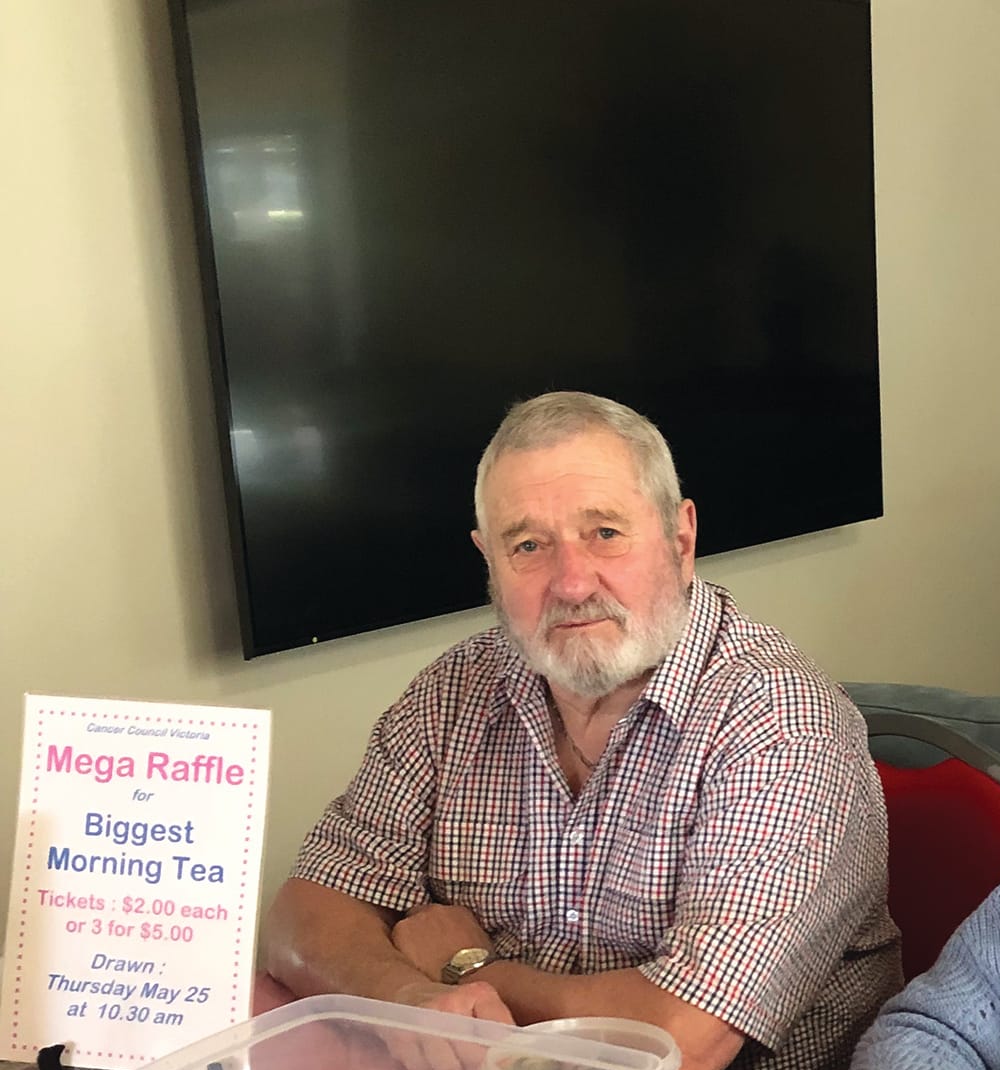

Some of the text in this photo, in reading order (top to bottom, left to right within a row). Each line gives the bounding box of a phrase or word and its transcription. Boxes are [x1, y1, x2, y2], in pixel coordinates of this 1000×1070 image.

[86, 722, 210, 740] Cancer Council Victoria
[46, 744, 245, 786] Mega Raffle
[132, 789, 155, 802] for
[84, 812, 195, 847] Biggest
[46, 846, 224, 885] Morning Tea
[37, 889, 105, 911] Tickets
[122, 895, 176, 917] $2.00
[180, 904, 228, 921] each
[65, 918, 194, 943] or 3 for $5.00
[90, 953, 155, 975] Drawn
[48, 973, 212, 1005] Thursday May 25
[66, 1001, 184, 1026] at 10.30 am
